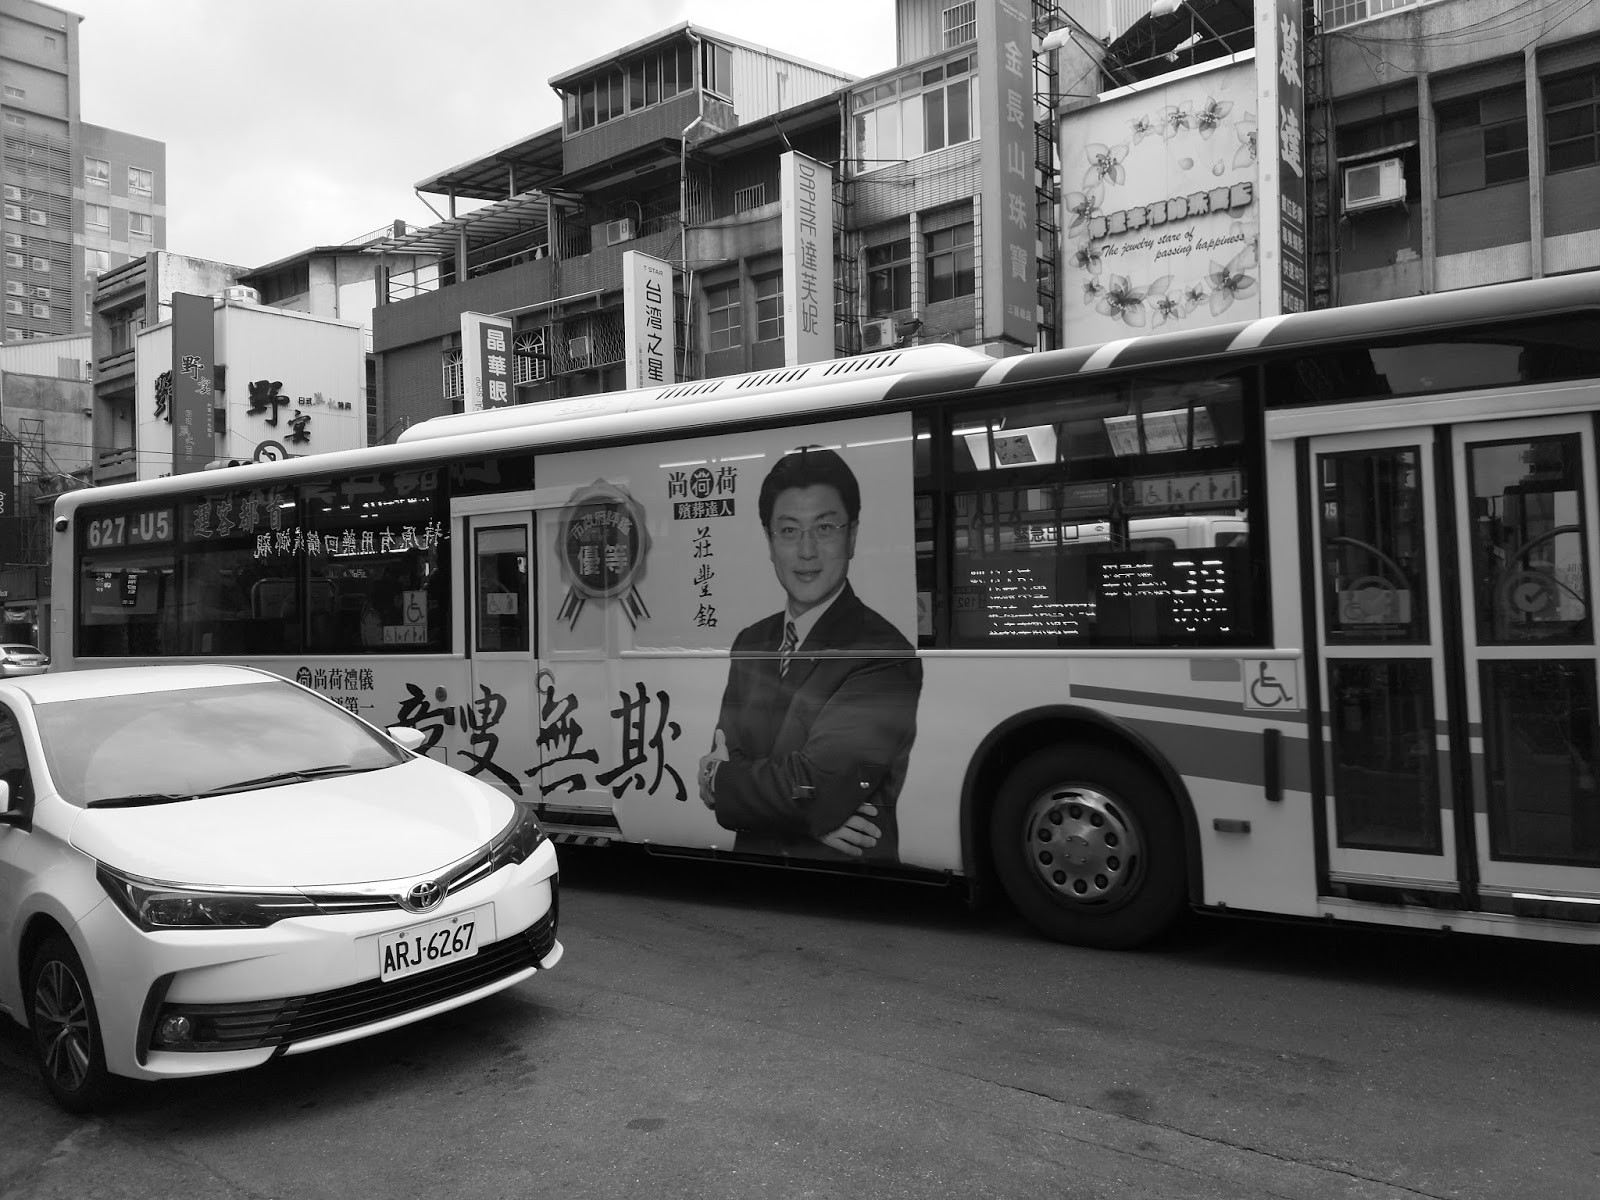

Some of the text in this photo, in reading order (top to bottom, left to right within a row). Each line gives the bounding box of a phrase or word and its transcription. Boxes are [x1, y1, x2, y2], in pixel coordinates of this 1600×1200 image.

[1004, 40, 1028, 283] 金長山珠寶
[799, 163, 816, 238] DAPHNE
[1101, 244, 1119, 258] The
[1120, 237, 1155, 256] jewelry
[1184, 226, 1195, 243] of
[1153, 233, 1245, 263] passing happiness
[648, 266, 664, 276] STAR
[801, 238, 818, 336] 達芙妮
[646, 279, 663, 382] 台灣之星
[487, 328, 508, 409] 晶華眼
[571, 509, 634, 540] 市政府評鑑
[678, 501, 733, 520] 殯葬達人
[577, 544, 628, 576] 優等
[693, 526, 718, 628] 莊豐銘
[314, 667, 374, 691] 尚荷禮儀
